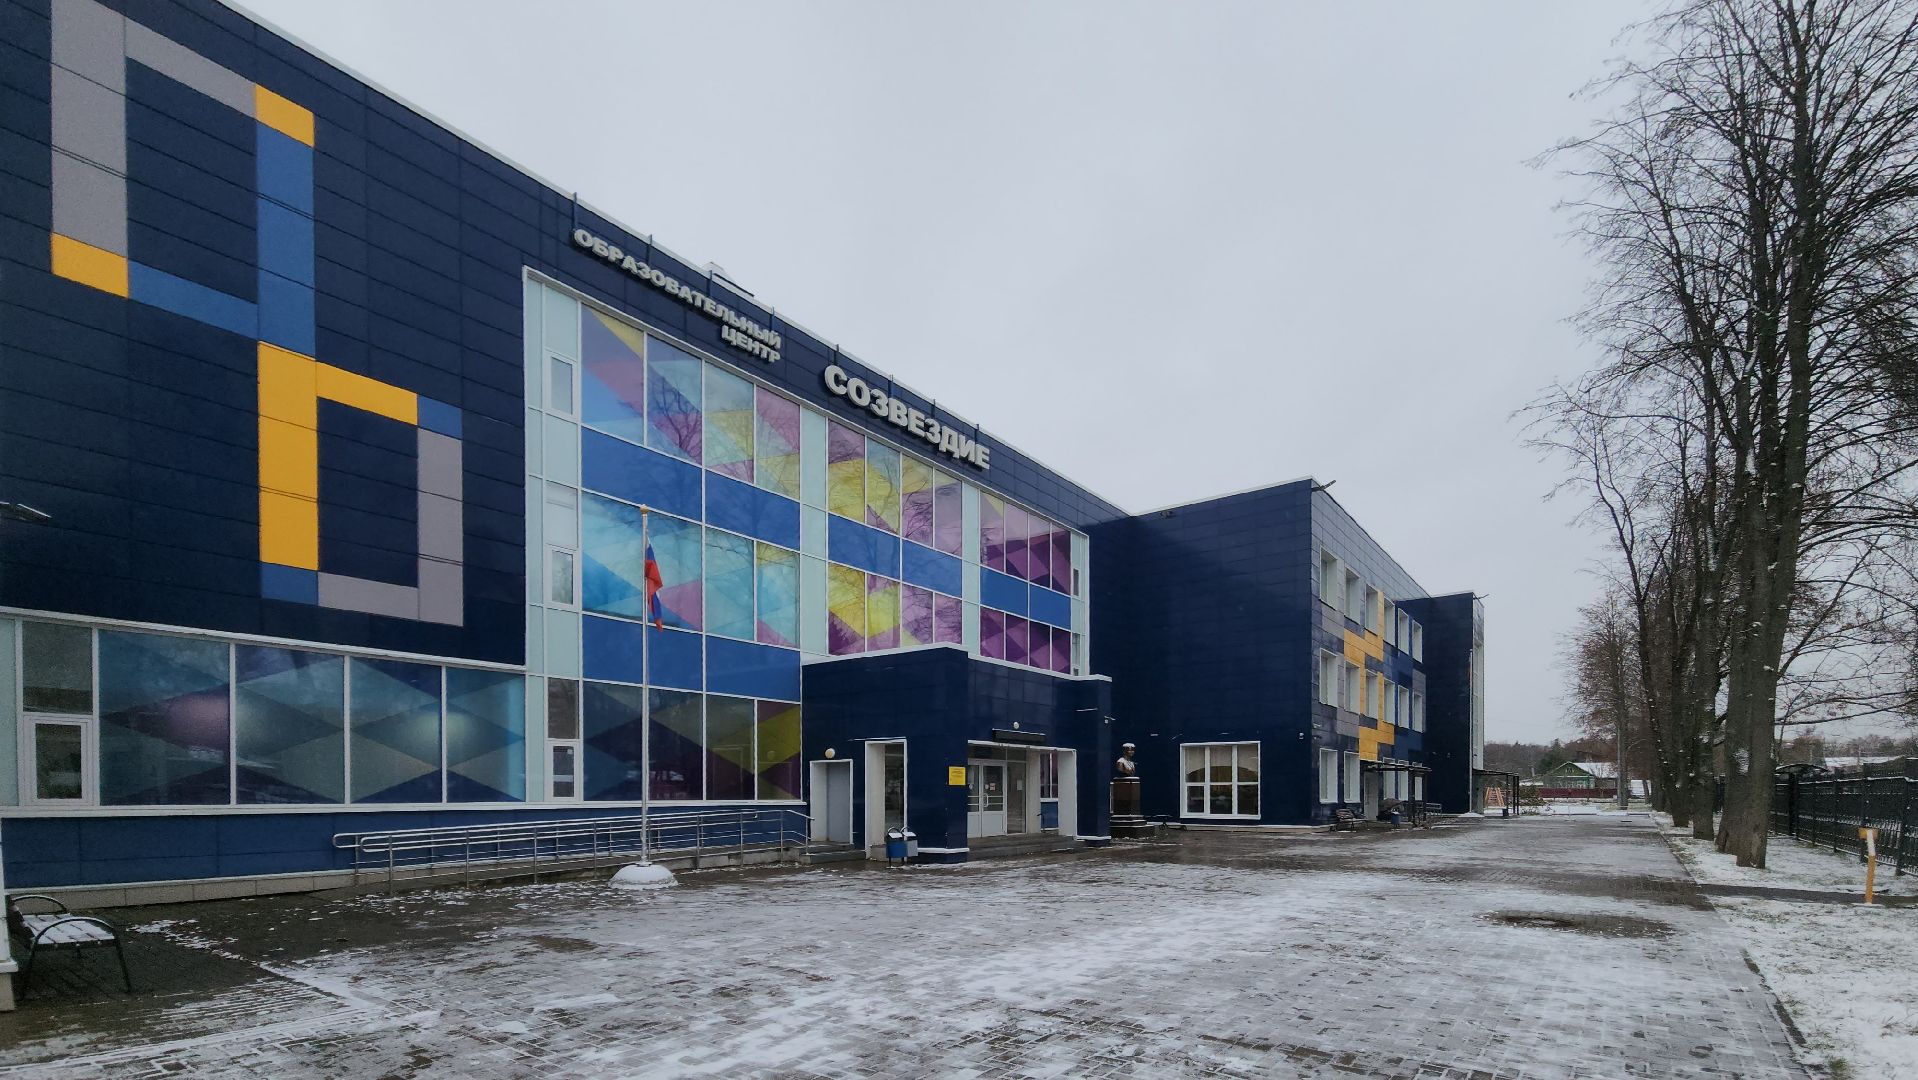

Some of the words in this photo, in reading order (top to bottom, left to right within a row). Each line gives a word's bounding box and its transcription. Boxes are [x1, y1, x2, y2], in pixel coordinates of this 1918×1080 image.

[574, 229, 781, 349] ОБРАЗОВАТЕЛЬНЫЙ
[721, 325, 781, 363] ЦЕНТР
[824, 364, 990, 470] СОЗВЕЗДИЕ
